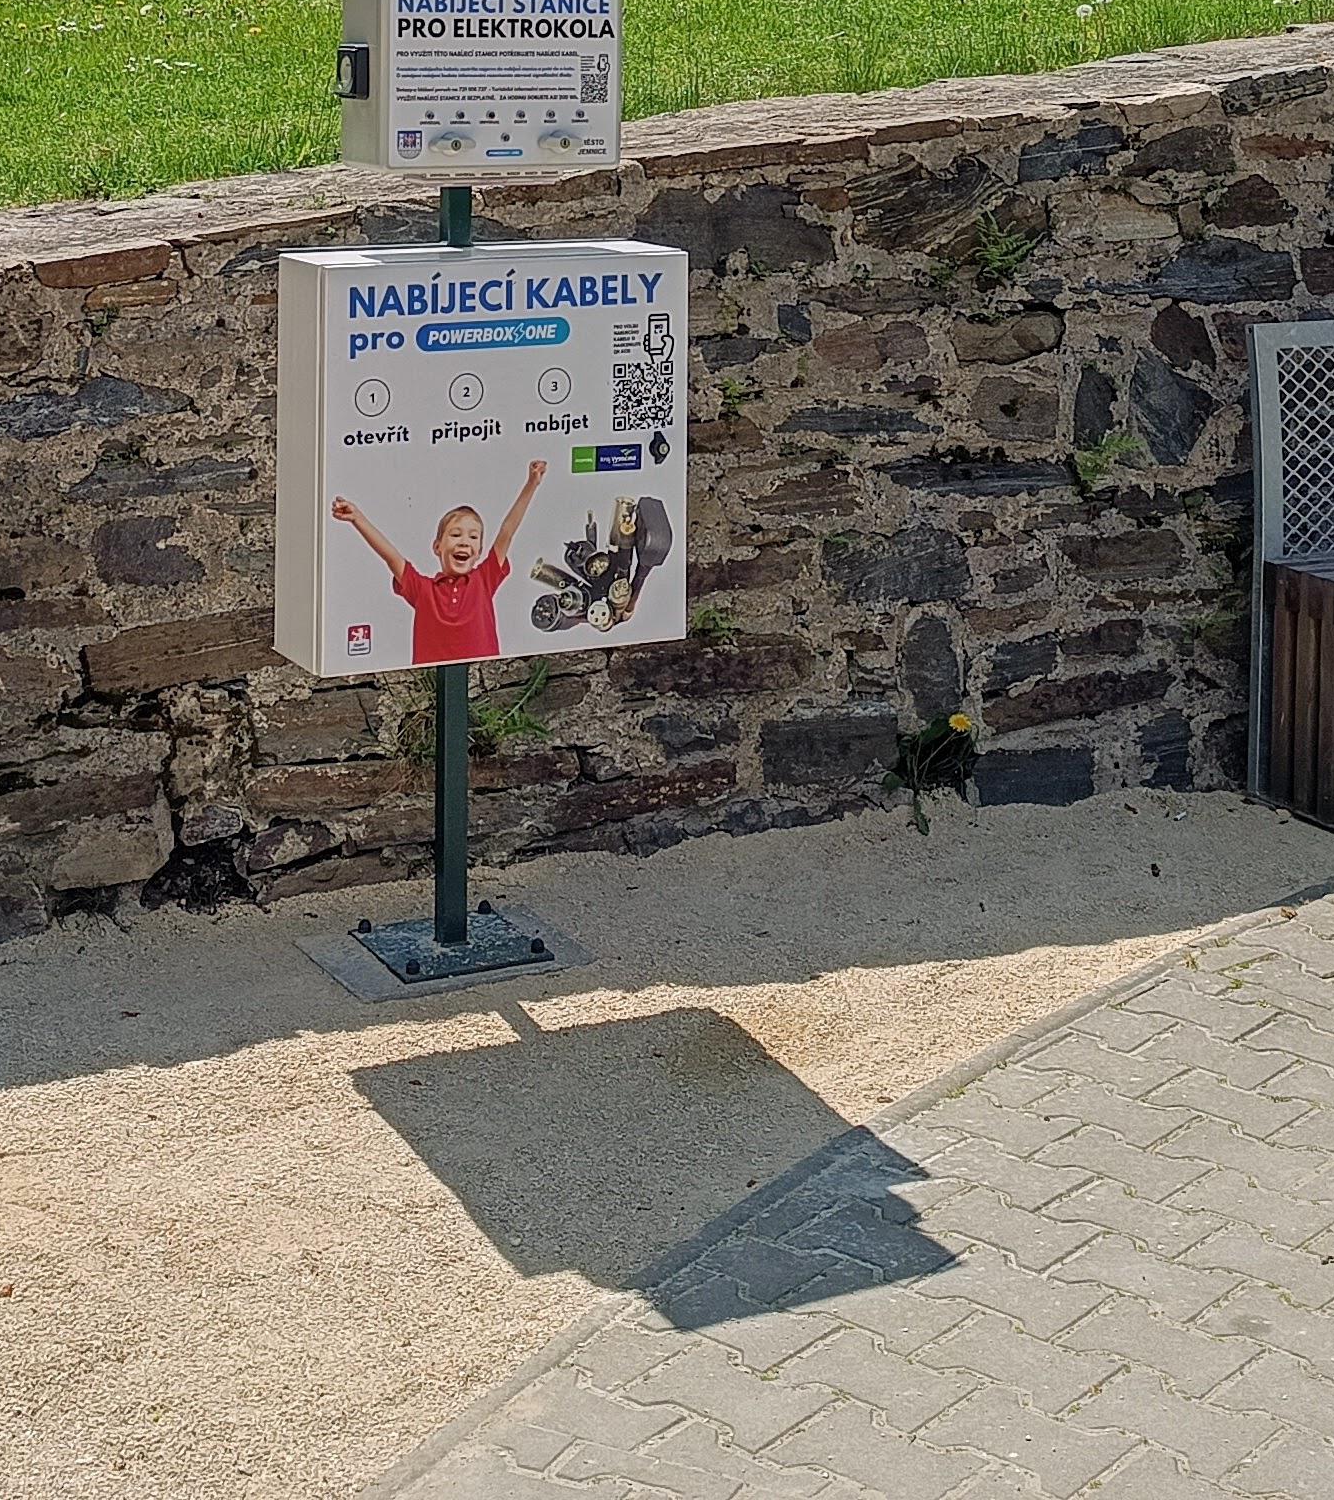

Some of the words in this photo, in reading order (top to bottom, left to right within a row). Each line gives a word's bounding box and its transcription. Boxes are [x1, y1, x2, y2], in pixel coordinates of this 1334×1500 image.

[397, 18, 446, 38] PRO
[453, 18, 615, 38] ELEKTROKOLA
[577, 148, 607, 156] JEMNICE
[582, 137, 605, 146] ĚSTO
[349, 268, 516, 319] NABÍJECÍ
[526, 273, 663, 310] KABELY
[349, 330, 405, 360] pro
[427, 326, 515, 346] POWERBOX
[524, 323, 558, 341] ONE
[369, 393, 376, 404] 1
[463, 386, 471, 398] 2
[551, 381, 559, 392] 3
[343, 425, 410, 446] otevřít
[431, 418, 502, 445] připojit
[525, 413, 590, 435] nabíjet
